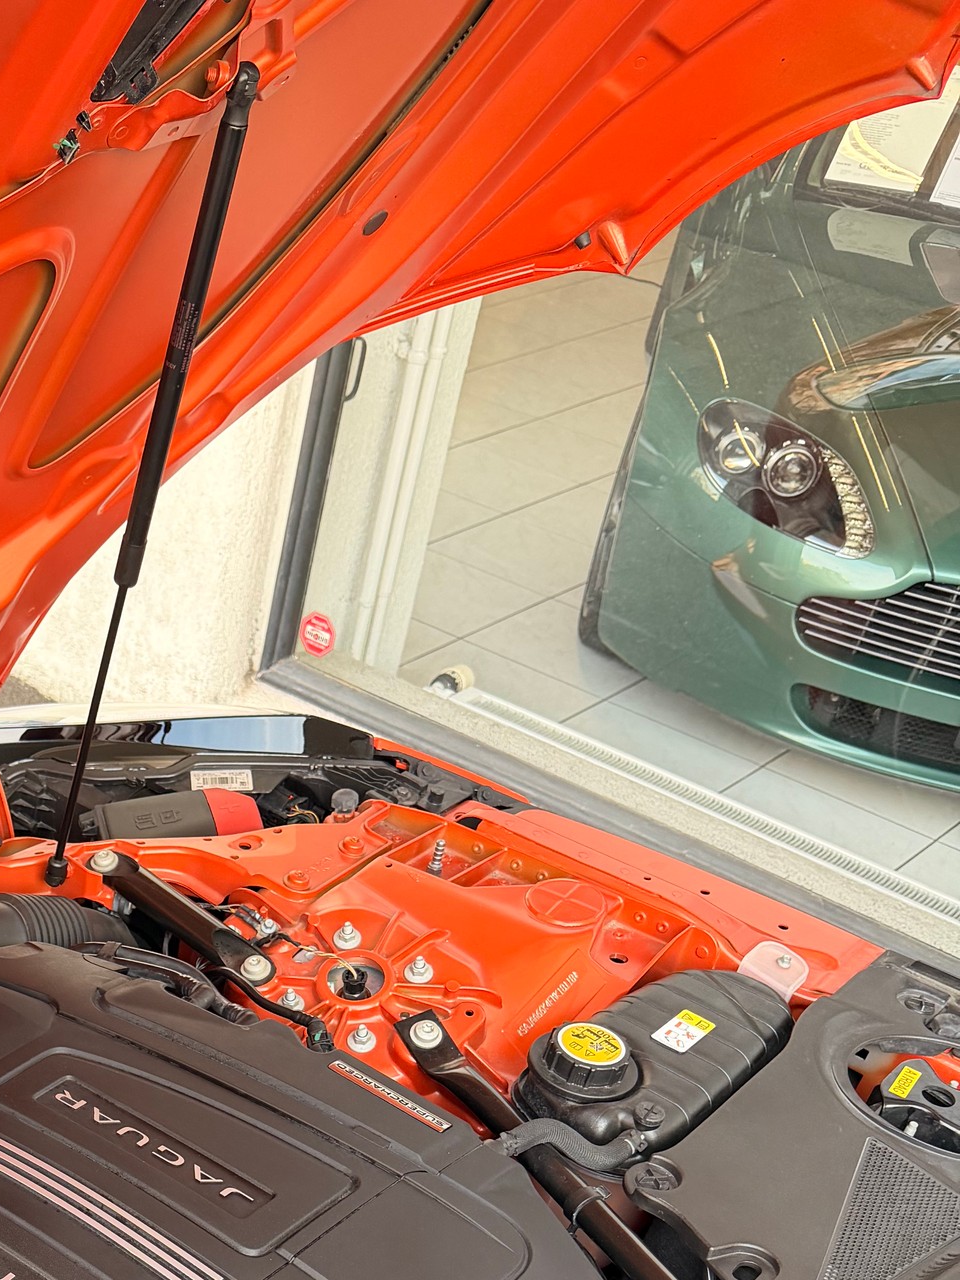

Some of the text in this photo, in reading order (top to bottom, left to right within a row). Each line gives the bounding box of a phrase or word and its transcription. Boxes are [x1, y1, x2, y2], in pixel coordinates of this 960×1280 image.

[336, 1062, 444, 1127] SUPERCHARGED
[893, 1068, 918, 1095] AIRBAG
[54, 1089, 256, 1202] JAGUAR
